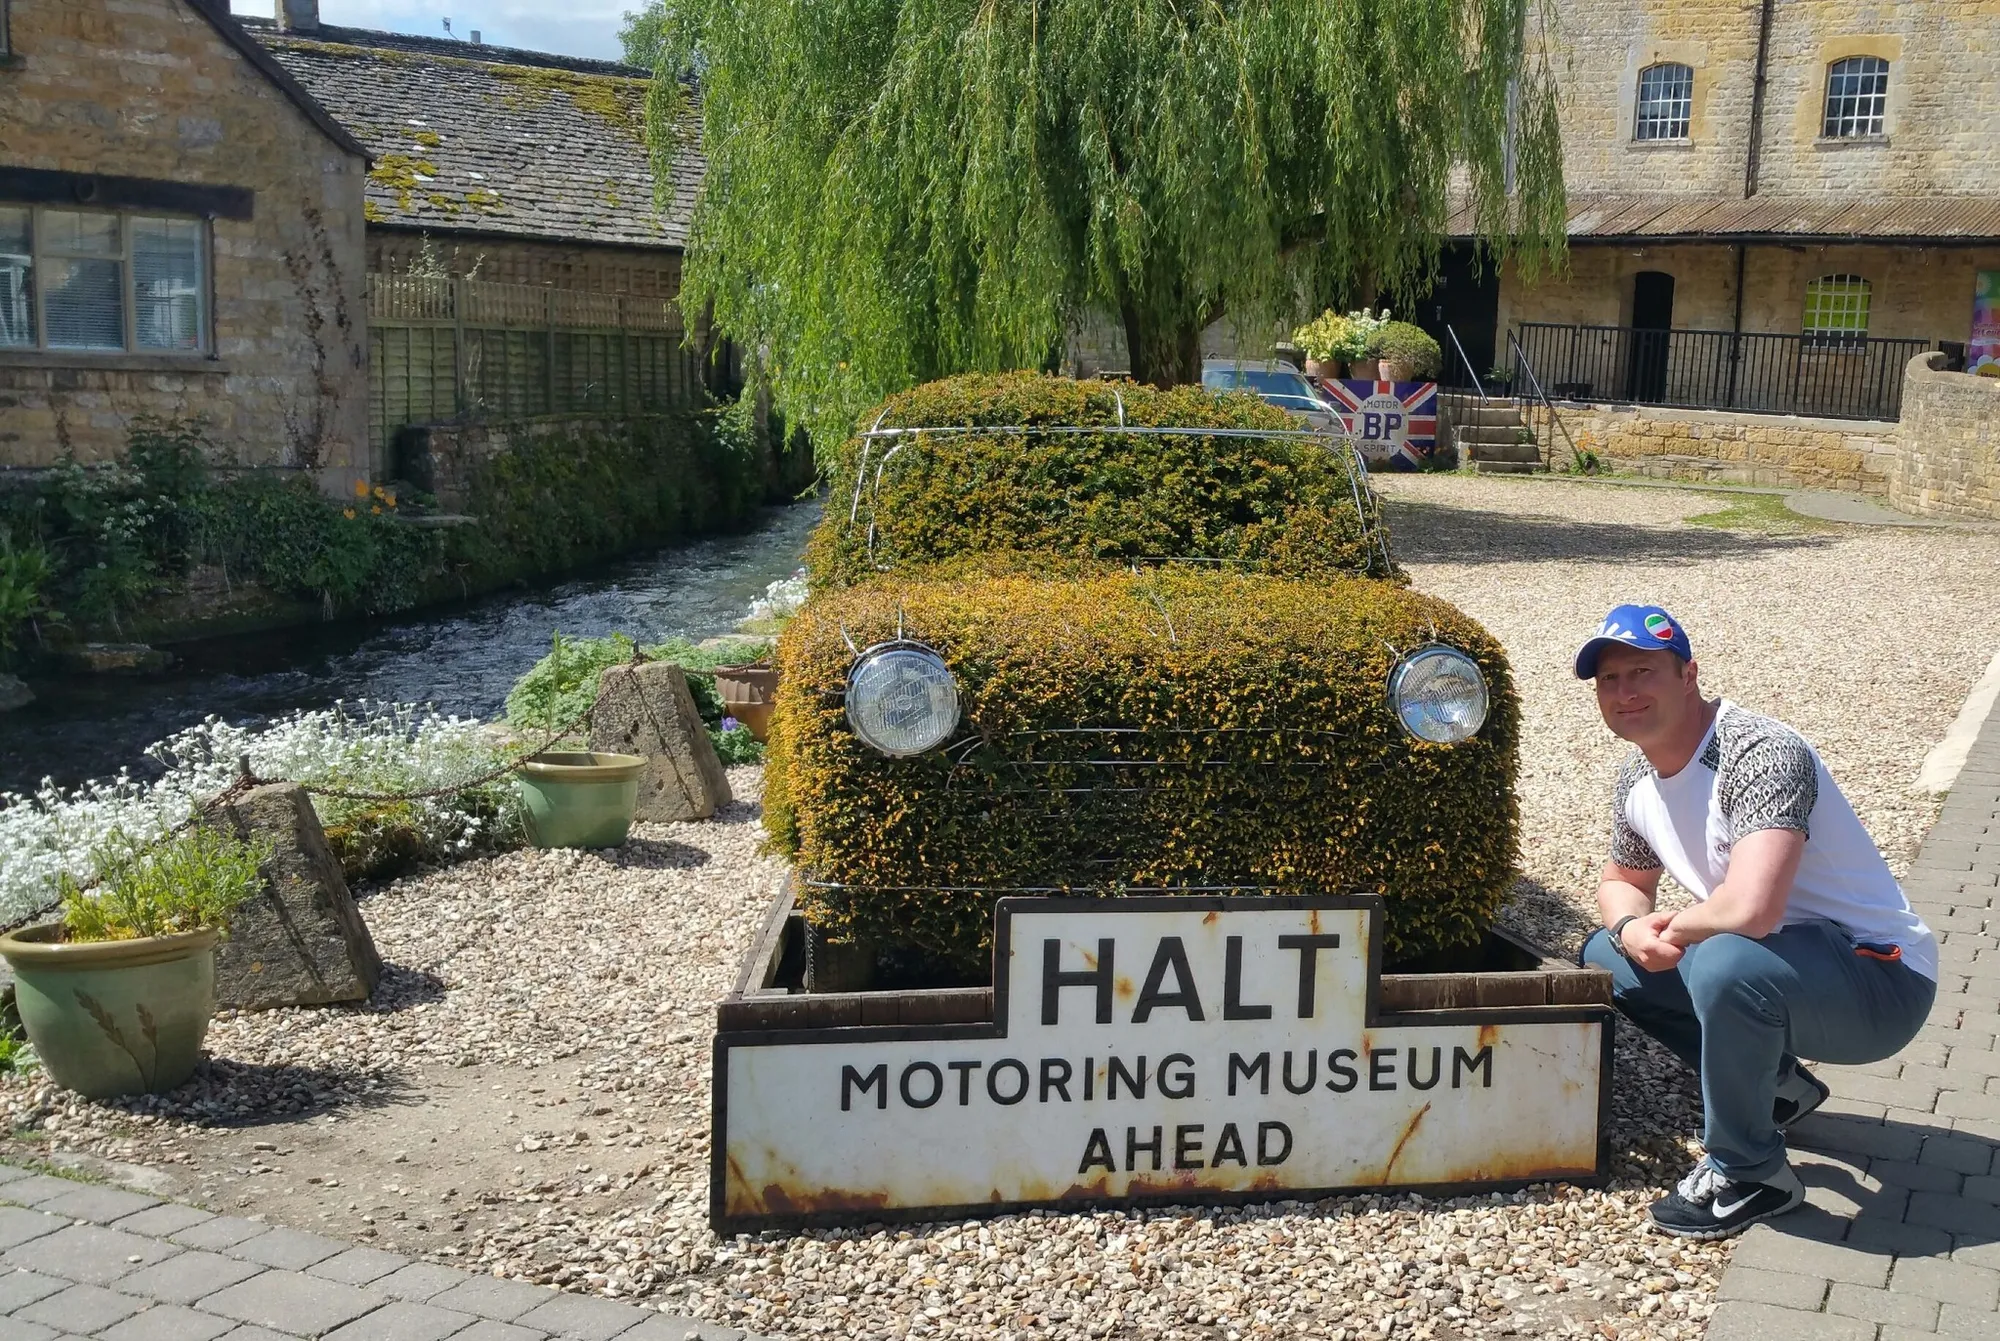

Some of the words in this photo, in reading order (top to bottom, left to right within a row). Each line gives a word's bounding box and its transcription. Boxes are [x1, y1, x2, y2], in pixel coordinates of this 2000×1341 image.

[1367, 400, 1398, 409] MOTOR
[1361, 413, 1402, 440] BP
[1364, 444, 1396, 453] SPIRIT
[1041, 934, 1340, 1025] HALT
[840, 1052, 1195, 1112] MOTORING
[1228, 1045, 1493, 1097] MUSEUM
[1078, 1121, 1293, 1174] AHEAD
